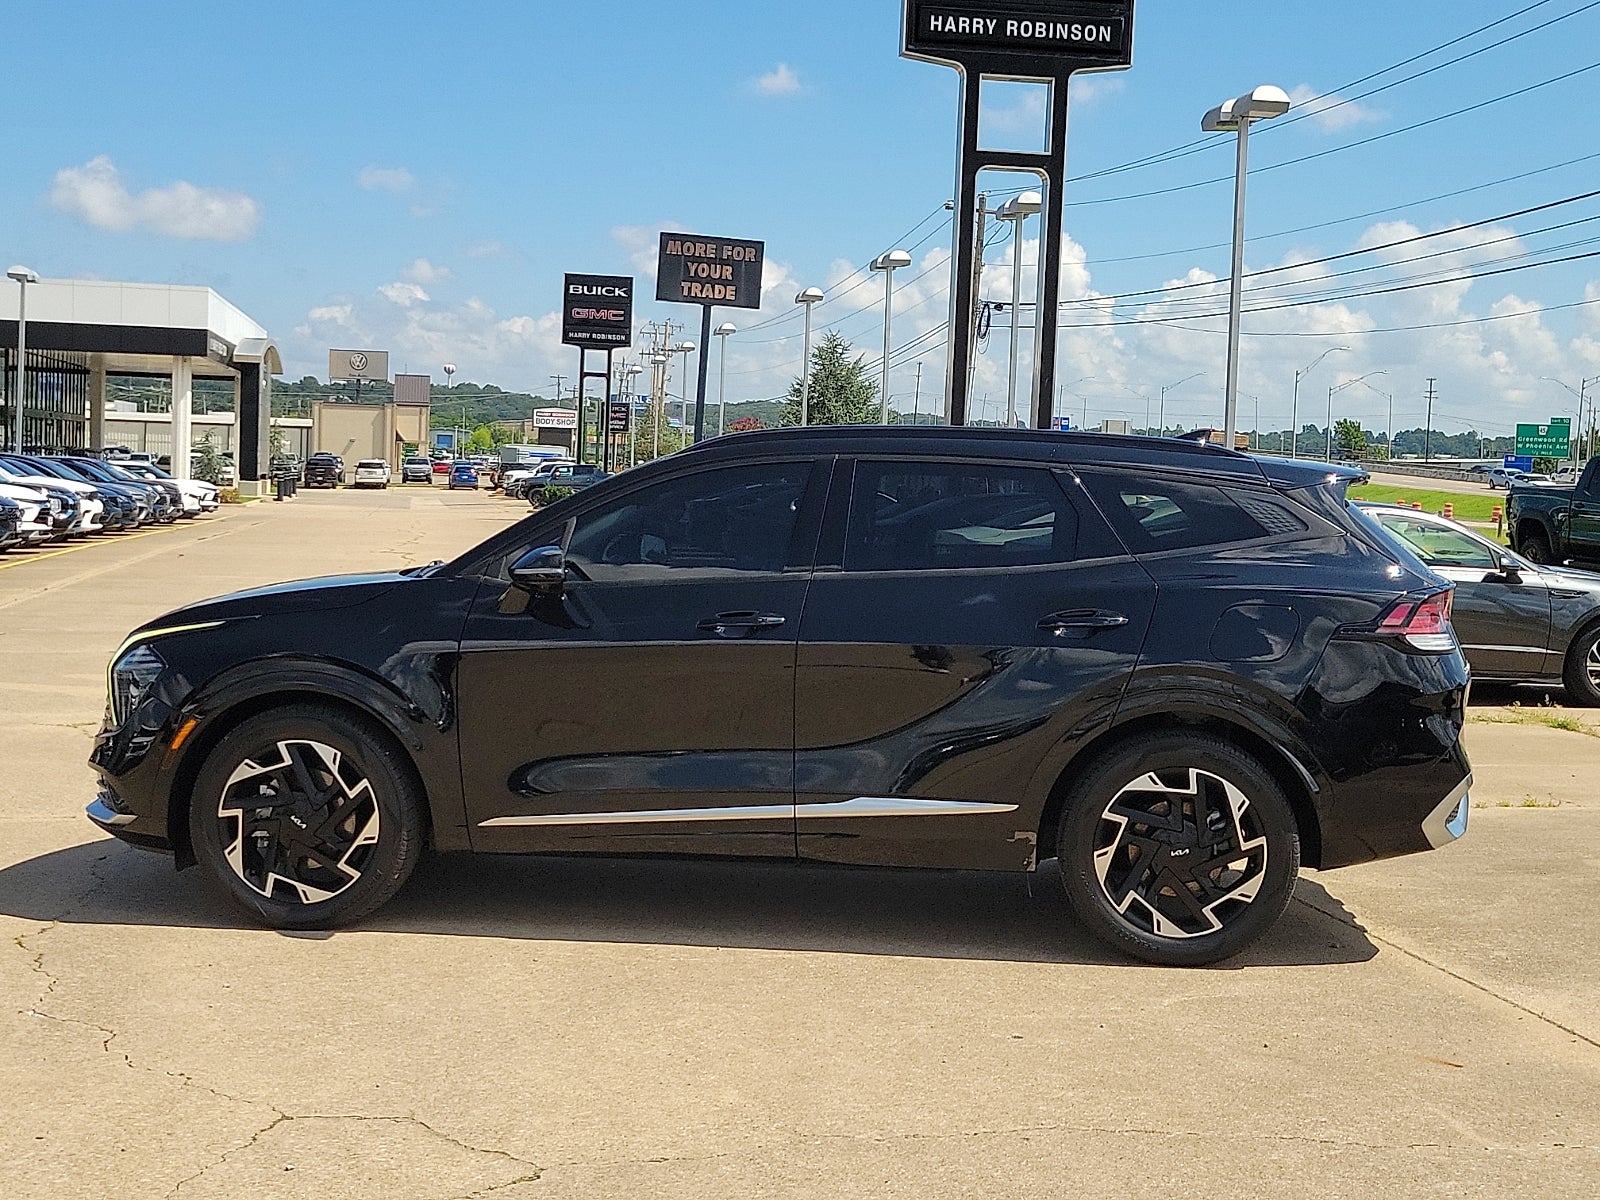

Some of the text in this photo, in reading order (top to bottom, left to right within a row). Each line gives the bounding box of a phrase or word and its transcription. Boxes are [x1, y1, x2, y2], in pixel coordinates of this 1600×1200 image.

[930, 15, 1112, 42] HARRY ROBINSON
[666, 240, 756, 262] MORE FOR
[687, 262, 733, 280] YOUR
[569, 285, 629, 297] BUICK
[681, 281, 736, 301] TRADE
[571, 307, 625, 321] GMC
[569, 331, 626, 341] HARRY ROBINSON
[1170, 848, 1190, 857] KIA
